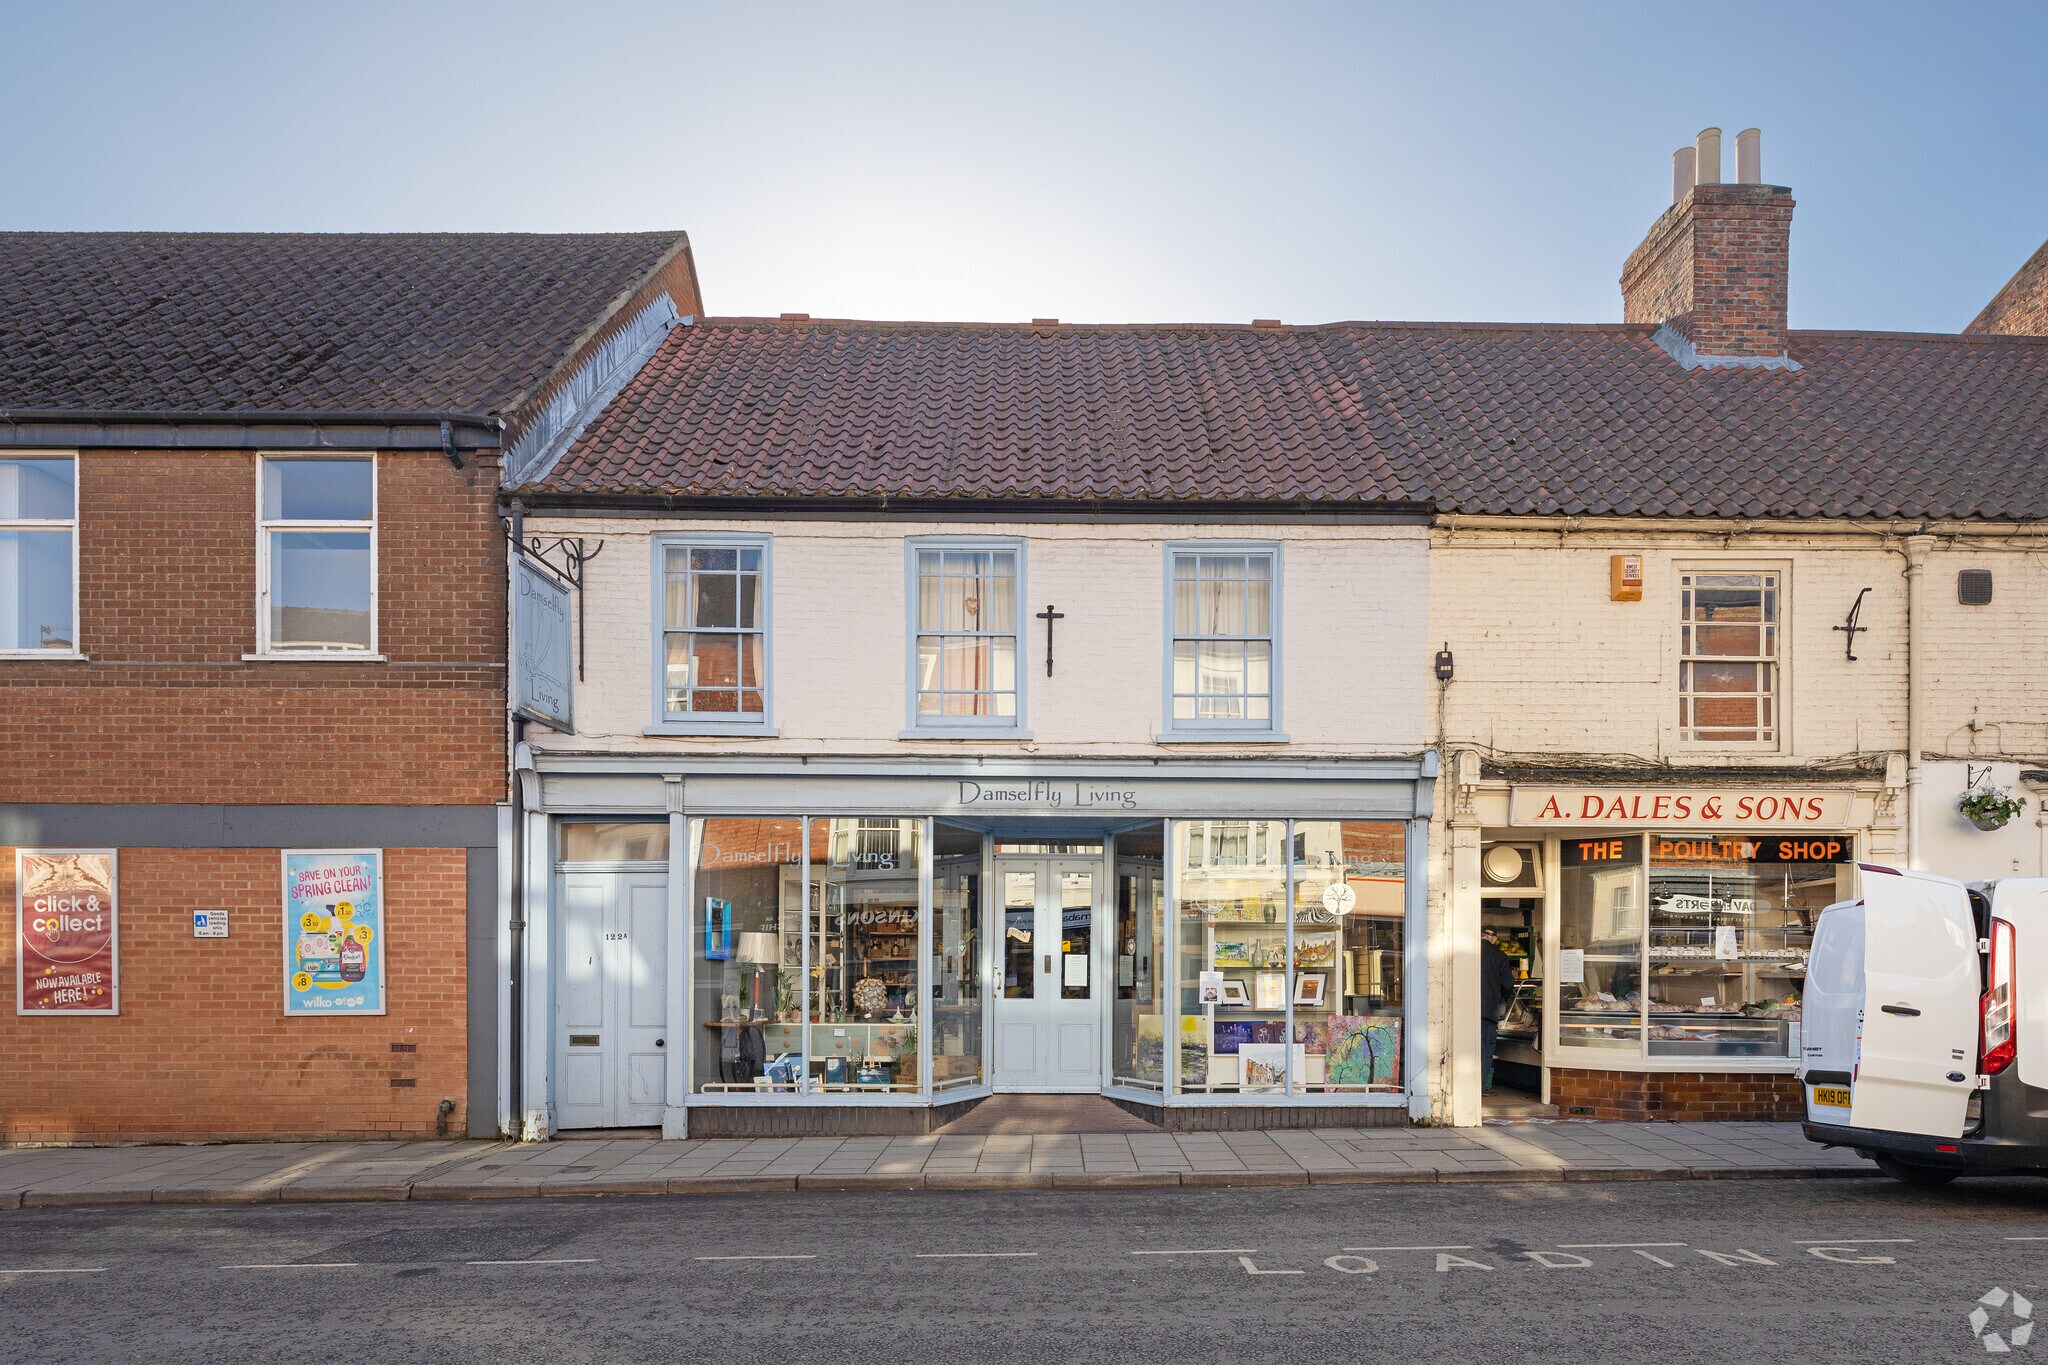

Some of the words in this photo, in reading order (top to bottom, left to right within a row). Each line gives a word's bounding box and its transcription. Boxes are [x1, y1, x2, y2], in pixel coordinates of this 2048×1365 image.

[520, 573, 564, 622] Damselfly
[531, 678, 560, 713] Living
[958, 780, 1062, 808] Damselfly
[1074, 781, 1137, 809] Living
[1535, 794, 1571, 820] A.
[1578, 795, 1692, 820] DALES
[1700, 795, 1724, 820] &
[1734, 796, 1825, 821] SONS
[697, 842, 802, 869] Damselfly
[831, 848, 895, 871] Living
[1578, 840, 1623, 861] THE
[1660, 840, 1762, 860] POULTRY
[1779, 841, 1842, 860] SHOP
[299, 869, 321, 882] SAVE
[323, 867, 337, 880] ON
[338, 865, 362, 878] YOUR
[291, 882, 332, 899] SPRING
[334, 875, 372, 894] CLEAN!
[33, 895, 83, 912] click
[86, 895, 101, 912] &
[338, 907, 352, 916] £1.50
[32, 915, 103, 932] collect
[303, 918, 319, 927] £3.50
[359, 931, 368, 939] £3
[35, 978, 58, 990] NOW
[58, 972, 102, 987] AVAILABLE
[298, 978, 307, 987] £8
[54, 986, 88, 1004] HERE!
[303, 996, 332, 1008] wilko
[1817, 1089, 1835, 1103] HK19
[1238, 1247, 1897, 1275] LOADING
